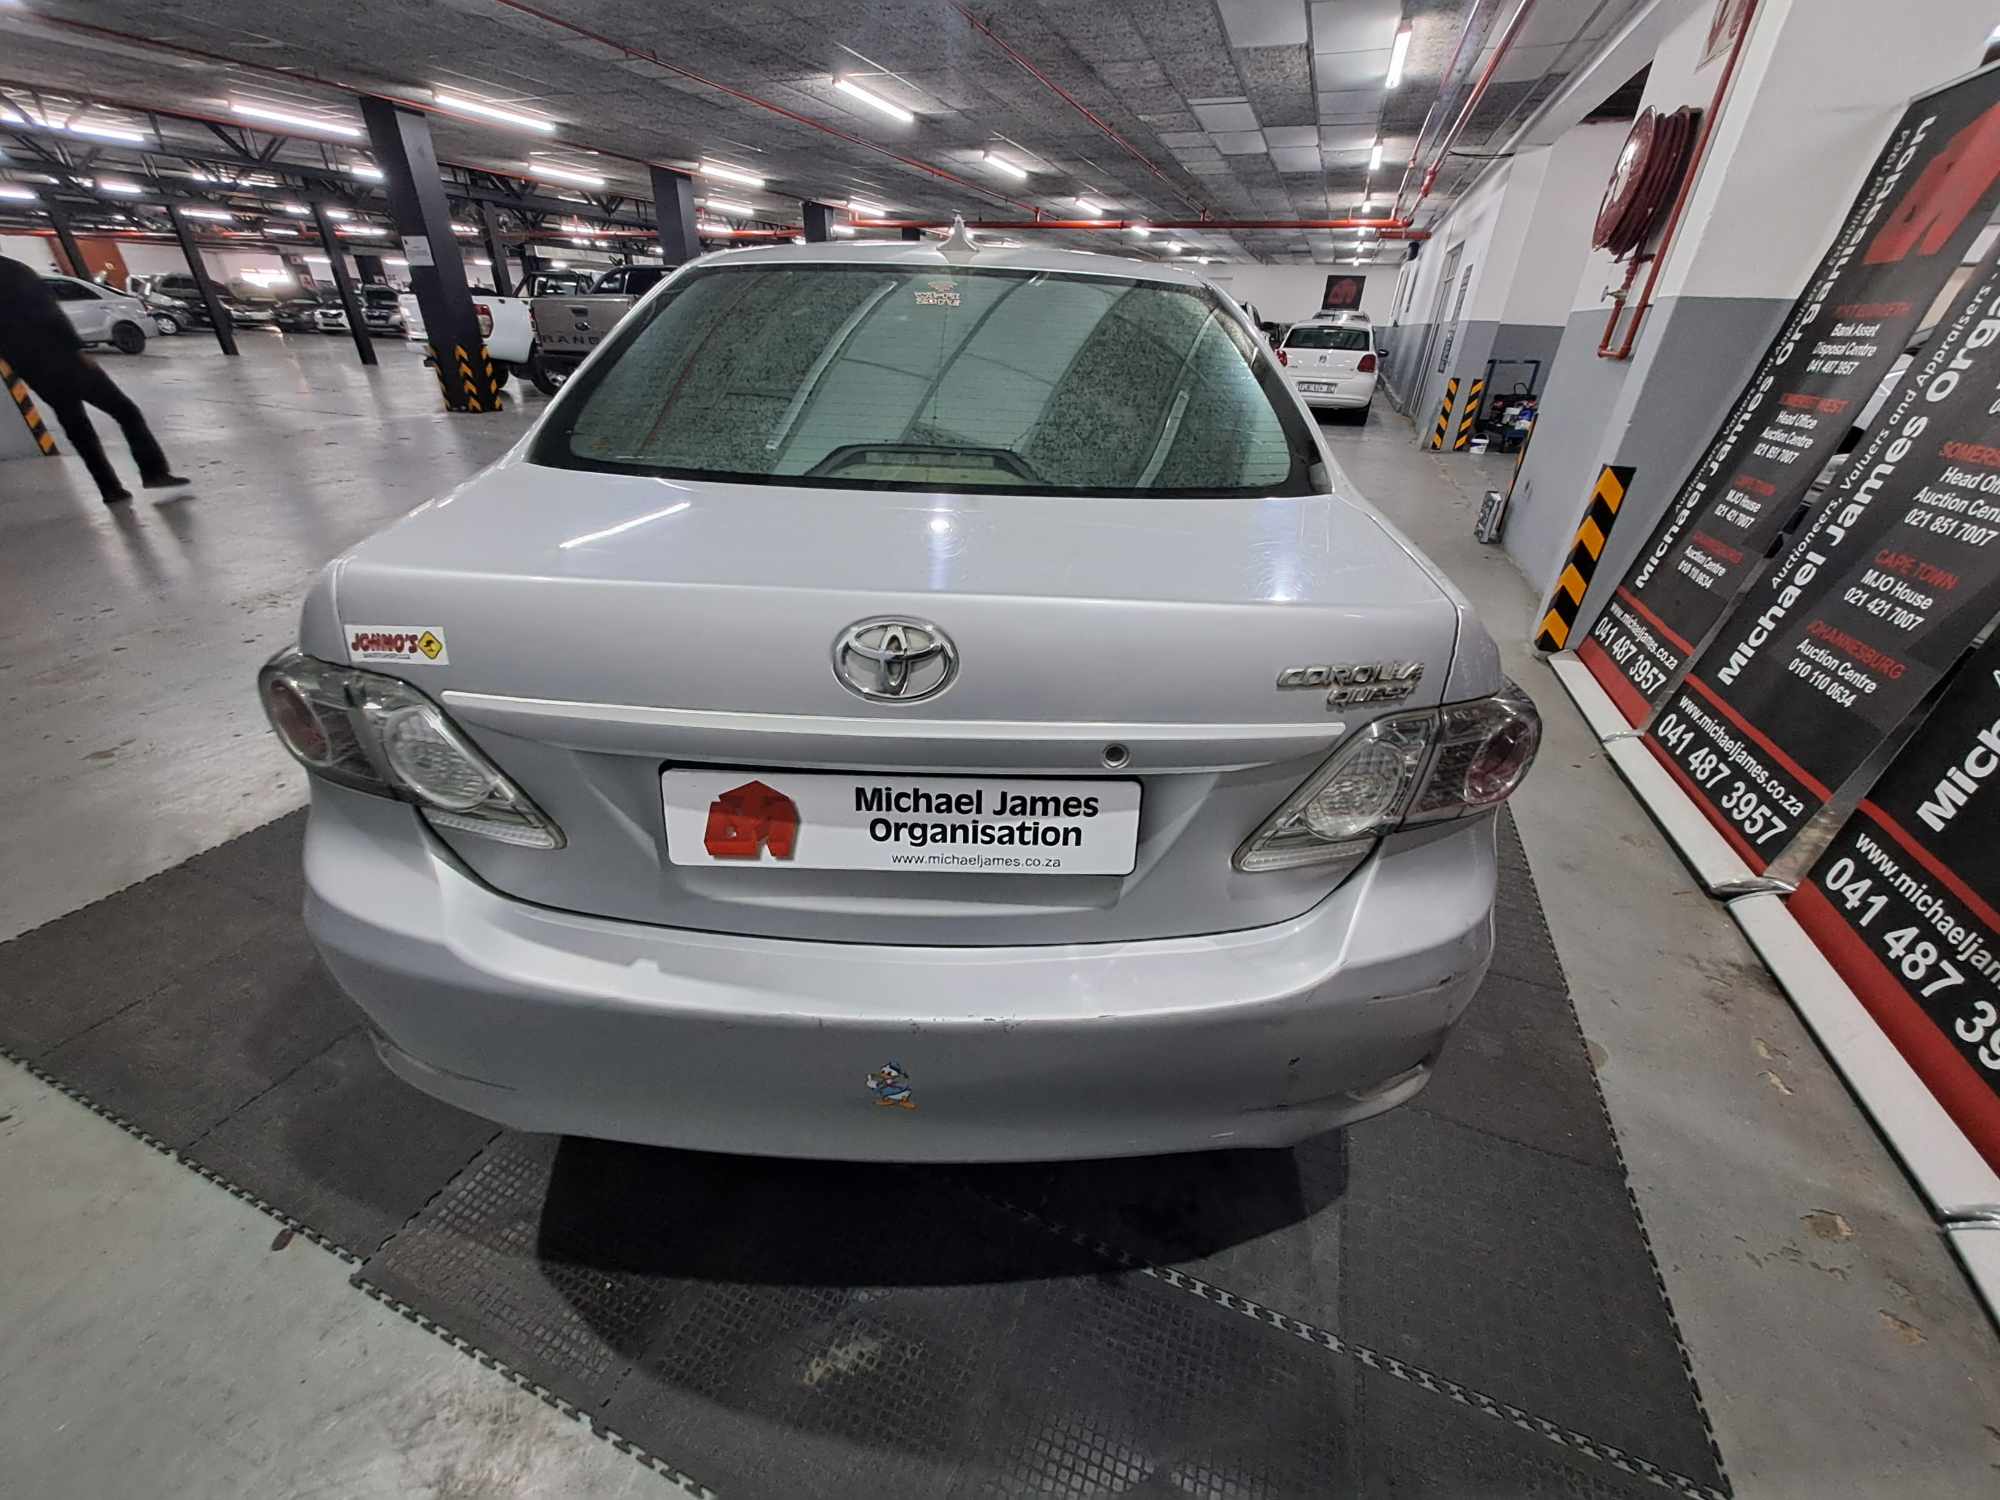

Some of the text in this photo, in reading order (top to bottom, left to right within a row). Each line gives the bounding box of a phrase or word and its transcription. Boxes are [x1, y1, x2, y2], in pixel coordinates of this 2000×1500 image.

[1635, 481, 1706, 588] Michael
[1709, 376, 1775, 477] James
[1776, 115, 1938, 365] Organisation
[1845, 342, 1878, 357] Centre
[1760, 426, 1814, 449] Auction Centre
[1772, 286, 1992, 590] Auctioneers, Valuers and Appraisers
[1775, 409, 1818, 430] Head Office
[1913, 486, 1969, 513] Auction
[1939, 466, 1985, 489] Head
[1904, 508, 1999, 546] 021 851 7007
[1703, 556, 1727, 577] Centre
[1717, 551, 1827, 686] Michael
[1825, 415, 1929, 546] James
[1874, 548, 1960, 592] CAPE TOWN
[1844, 586, 1925, 631] 021 421 7007
[1861, 568, 1934, 610] MJO House
[1594, 616, 1668, 695] 041 487 3957
[1609, 602, 1679, 671] www.michaeljames.co.za
[1807, 618, 1905, 680] JOHANNESBURG
[1276, 661, 1425, 688] COROLLA
[1788, 657, 1857, 708] 010 110 0634
[1796, 638, 1877, 694] Auction Centre
[1679, 696, 1805, 817] www.michaeljames.co.za
[1658, 713, 1788, 845] 041 487 3957
[855, 786, 1099, 818] Michael James
[869, 817, 1083, 848] Organisation
[891, 852, 1062, 869] www.michaeljames.co.za
[1825, 857, 1888, 927] 041
[1883, 926, 1965, 998] 487
